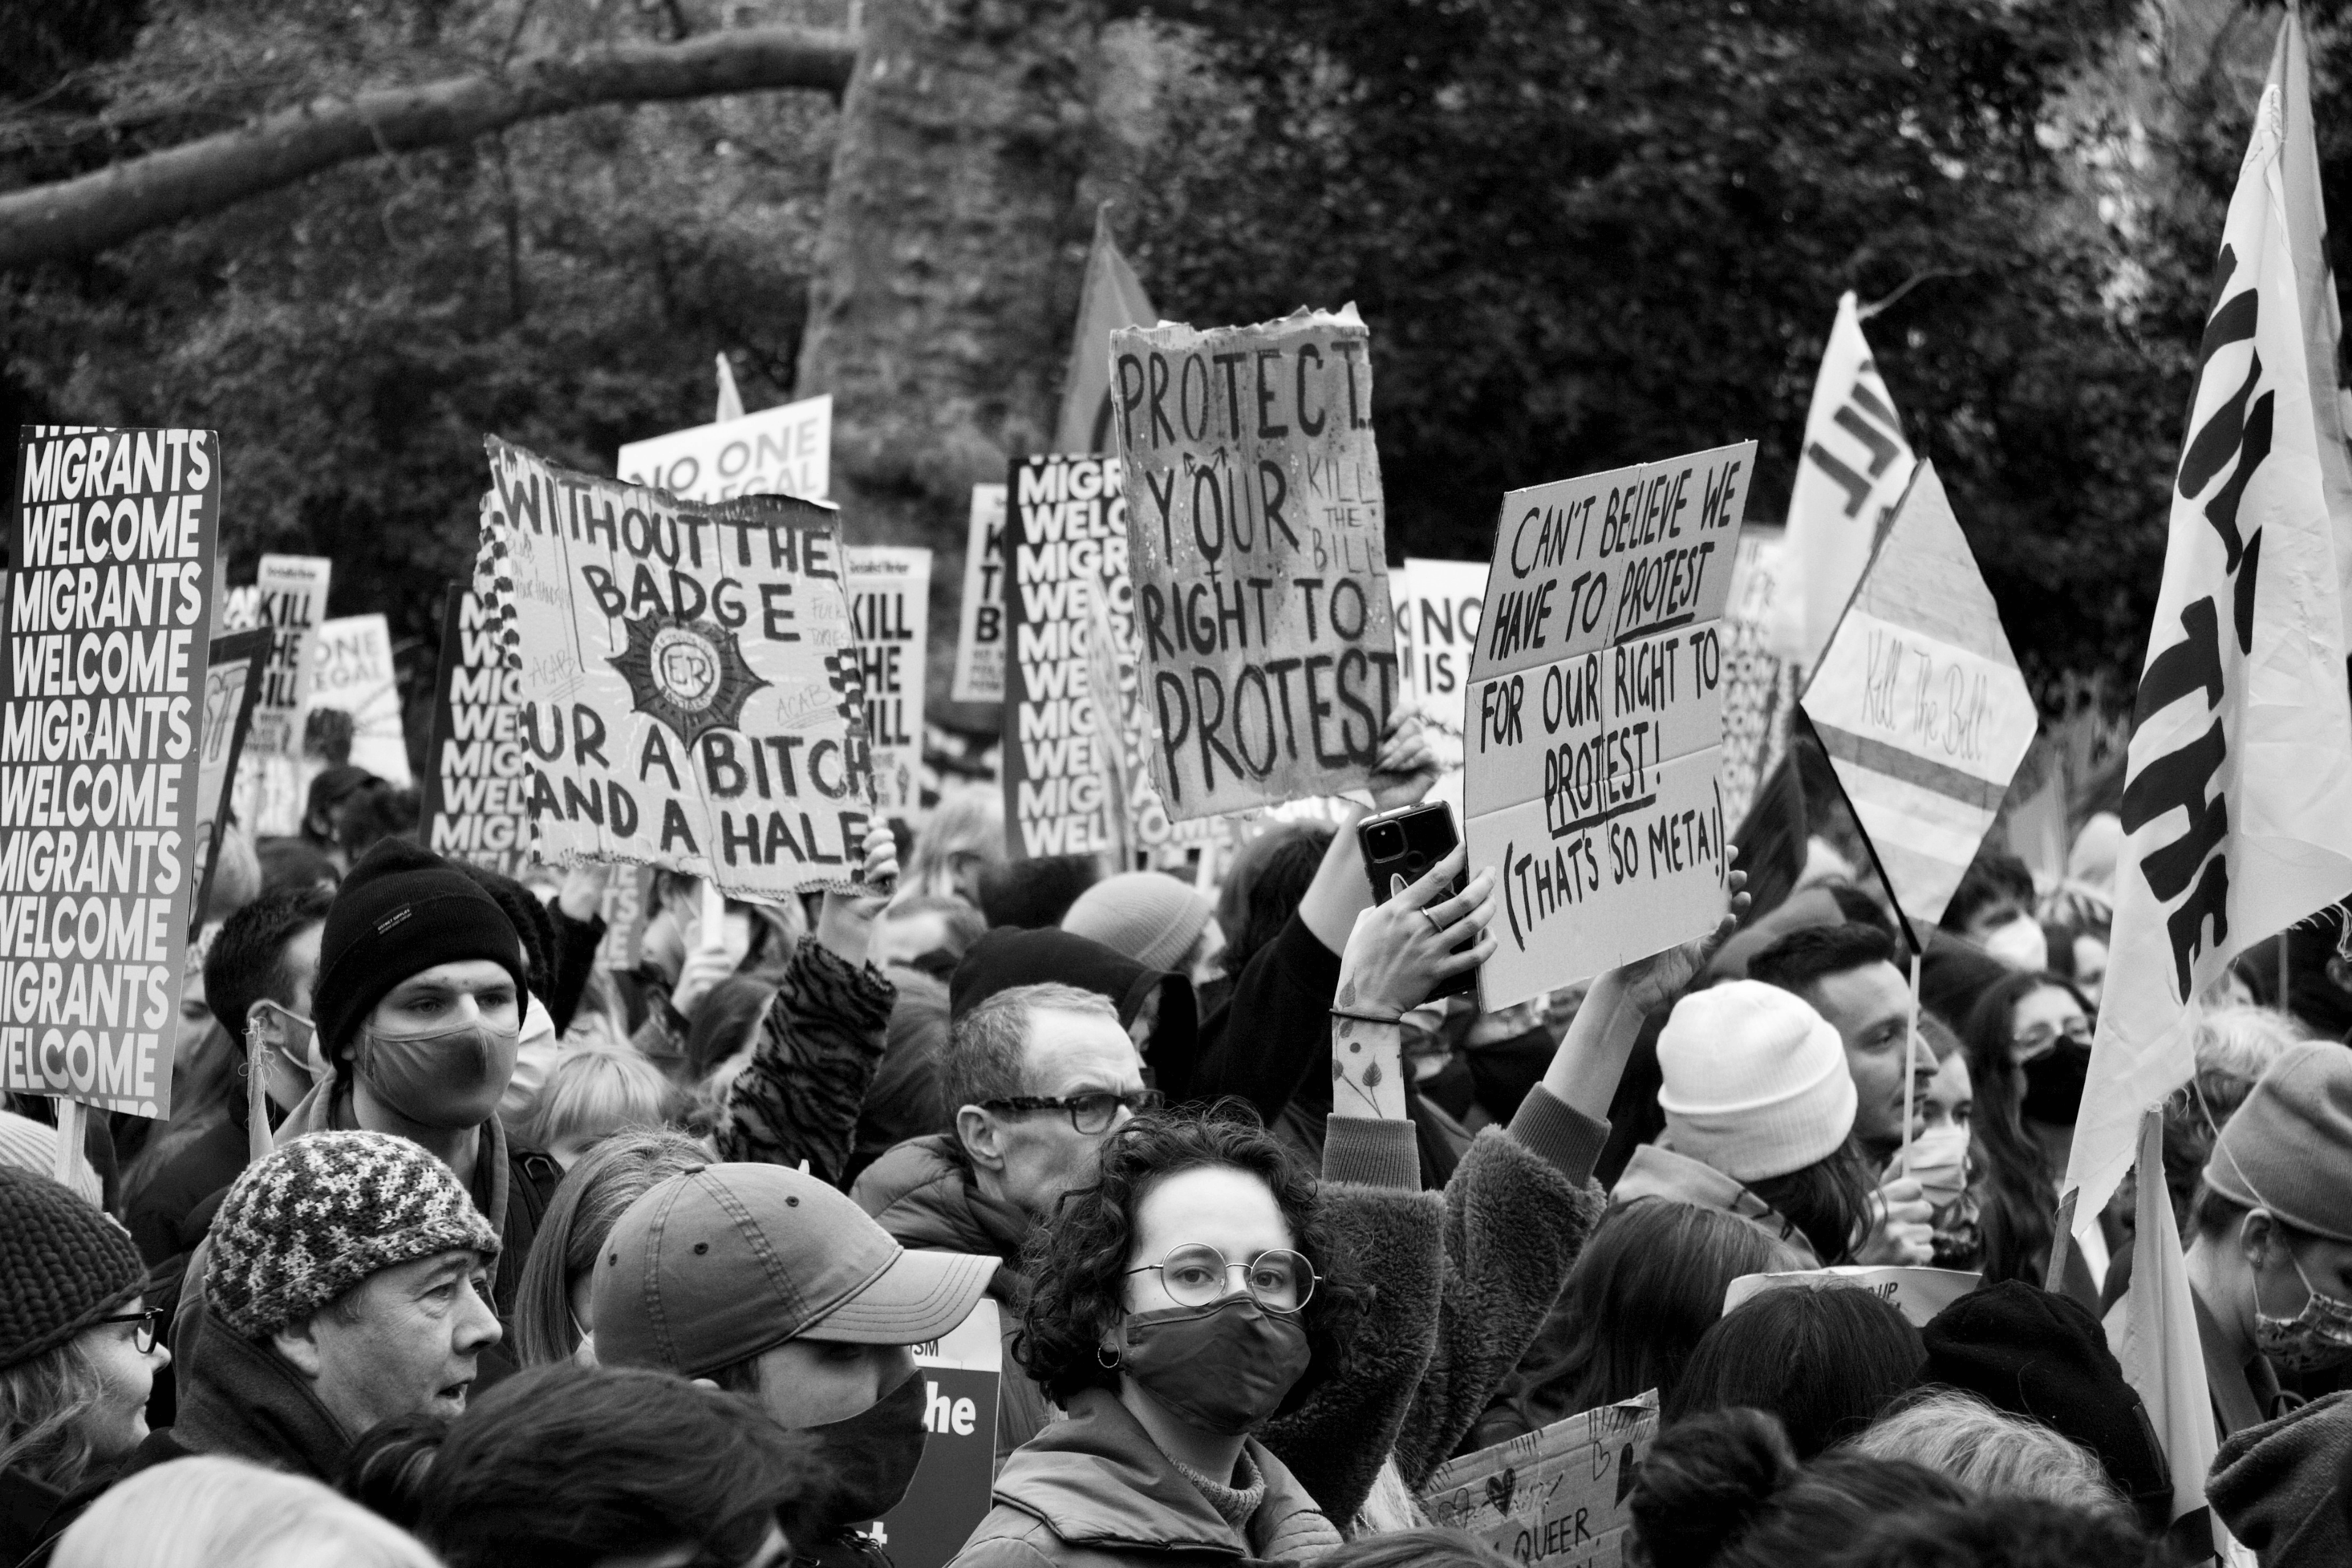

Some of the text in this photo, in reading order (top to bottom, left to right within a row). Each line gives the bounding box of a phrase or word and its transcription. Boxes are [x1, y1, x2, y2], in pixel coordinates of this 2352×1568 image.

[1117, 340, 1361, 452] PROTECT
[23, 429, 210, 503] MIGRANTS
[716, 417, 819, 480] ONE
[1307, 452, 1377, 504] KILL
[23, 494, 203, 567] WELCOME
[494, 464, 839, 581] WITHOUT THE
[1145, 459, 1300, 566] YOUR
[1323, 507, 1363, 532] THE
[1511, 461, 1742, 579] CAN'T BELIEVE WE
[1313, 528, 1388, 578] BILL
[11, 562, 203, 633] MIGRANTS
[581, 564, 801, 642] BADGE
[1142, 577, 1273, 662] RIGHT
[1293, 578, 1367, 642] TO
[1489, 579, 1557, 661] HAVE
[1566, 570, 1607, 643] TO
[1614, 541, 1715, 638] PROTEST
[12, 629, 192, 696] WELCOME
[268, 633, 301, 668] HE
[861, 646, 901, 693] HE
[1425, 652, 1455, 695] IS
[777, 684, 831, 723] ACAB
[867, 697, 911, 746] ILL
[1155, 648, 1399, 803] PROTEST
[1481, 628, 1719, 754] FOR OUR RIGHT TO
[1, 696, 192, 762] MIGRANTS
[526, 701, 609, 769] UR
[639, 724, 680, 791] A
[701, 733, 875, 801] BITCH
[1, 764, 182, 827] WELCOME
[530, 770, 638, 838] AND
[660, 799, 699, 853] A
[1544, 720, 1661, 832] PROTEST!
[1503, 775, 1725, 952] (THAT'S SO META!)
[0, 961, 170, 1030] IGRANTS
[923, 1381, 976, 1436] he
[1513, 1507, 1591, 1568] QUEER
